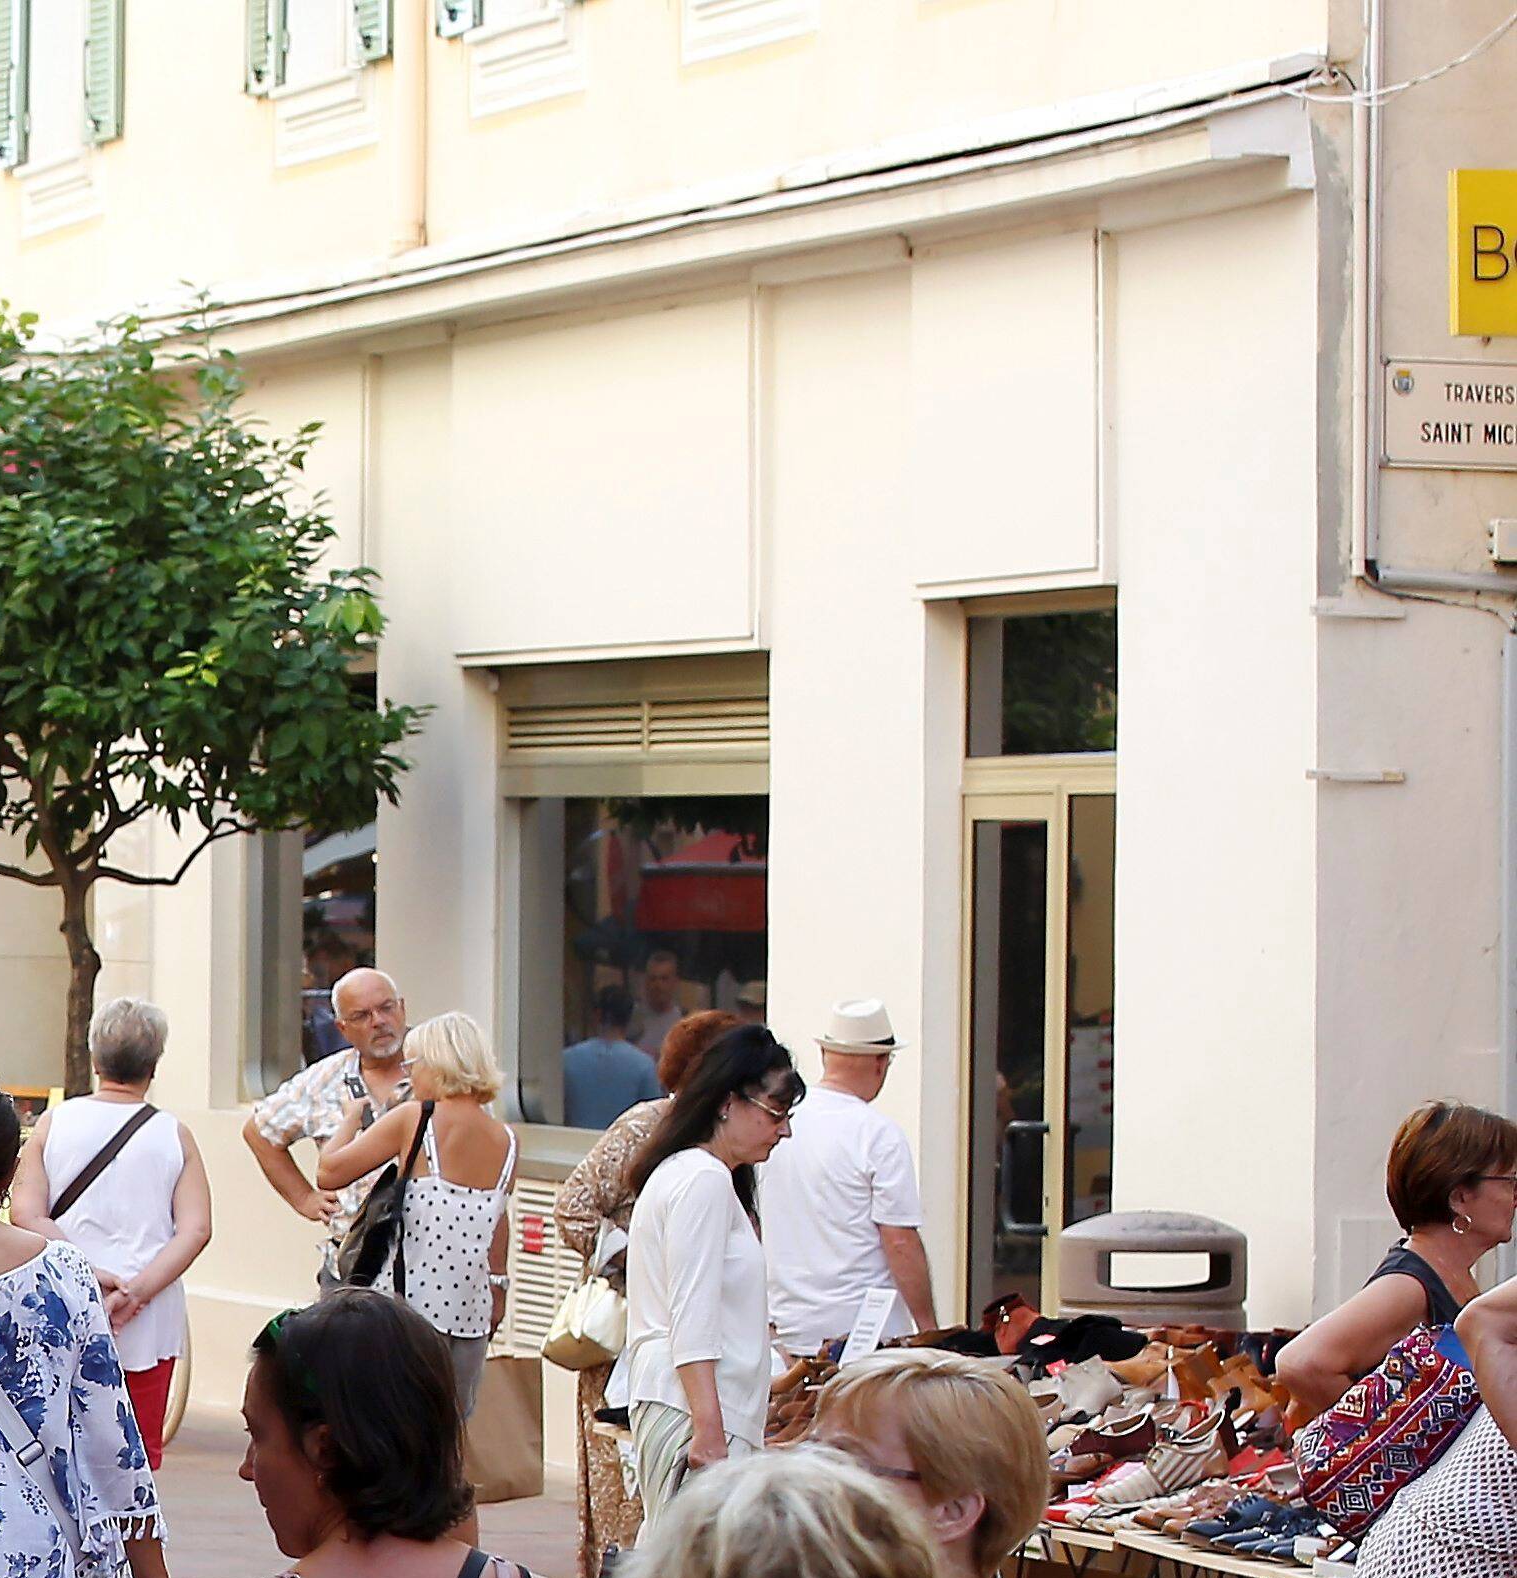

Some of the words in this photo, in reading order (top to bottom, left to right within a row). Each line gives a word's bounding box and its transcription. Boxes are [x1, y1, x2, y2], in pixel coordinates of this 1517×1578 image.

[1473, 225, 1517, 281] B
[1444, 383, 1517, 405] TRAVERS
[1421, 422, 1473, 444] SAINT
[1483, 423, 1517, 445] MIC
